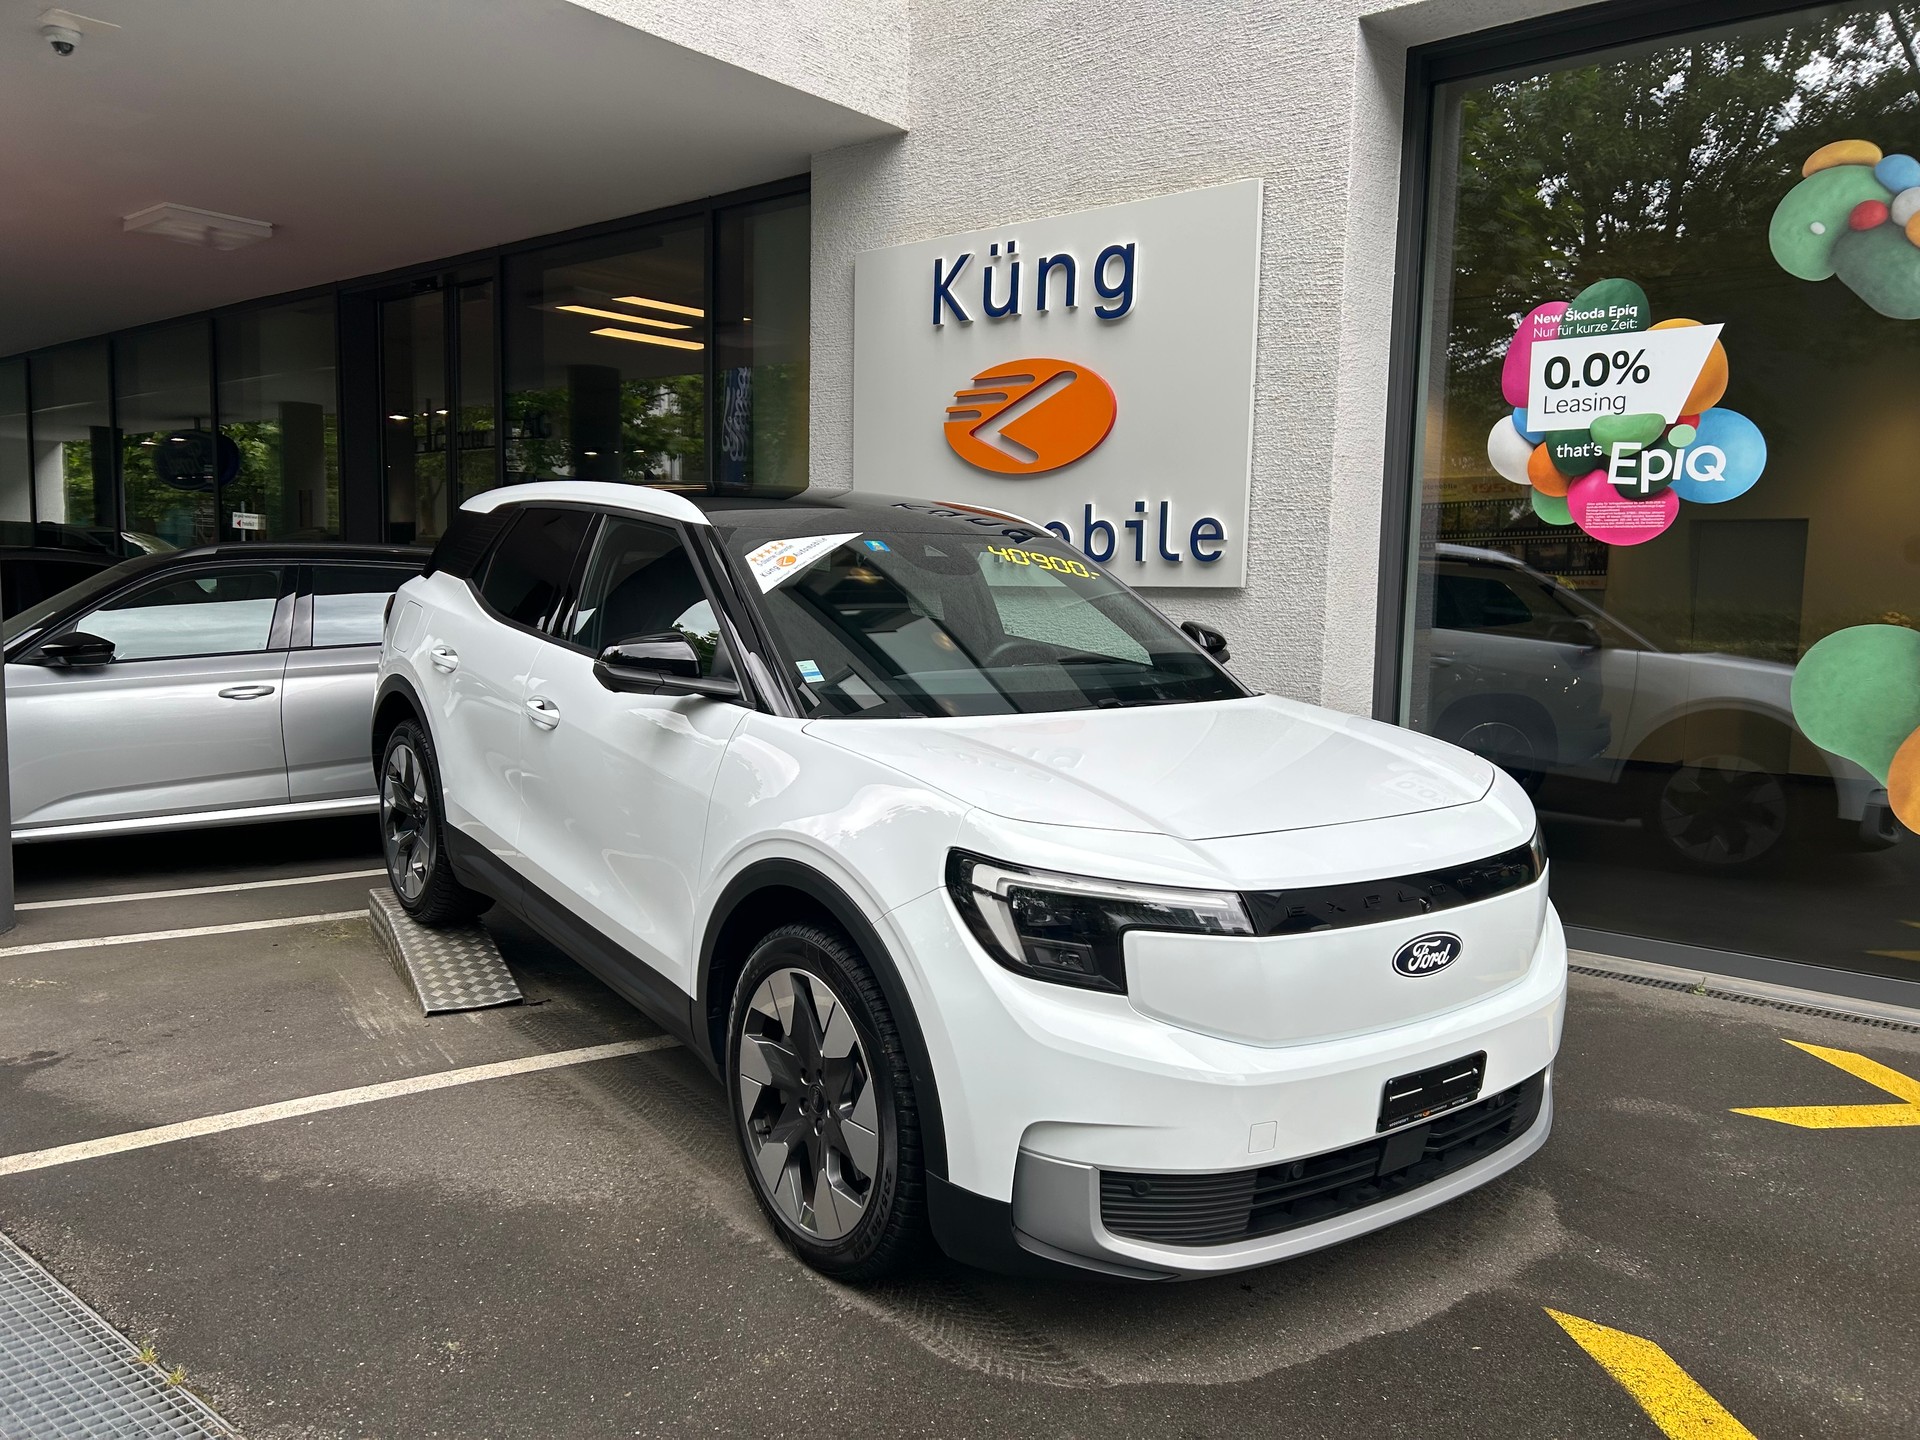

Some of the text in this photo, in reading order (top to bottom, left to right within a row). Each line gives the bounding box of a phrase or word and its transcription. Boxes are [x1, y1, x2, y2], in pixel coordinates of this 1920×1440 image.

[932, 240, 1139, 326] Küng
[1534, 304, 1638, 325] New Škoda Epiq
[1533, 319, 1638, 339] Nur für kurze Zeit:
[1543, 348, 1651, 391] 0.0%
[1543, 392, 1627, 416] Leasing
[1556, 442, 1603, 458] that's
[1286, 863, 1522, 919] EXPLORER
[1408, 939, 1451, 972] Ford
